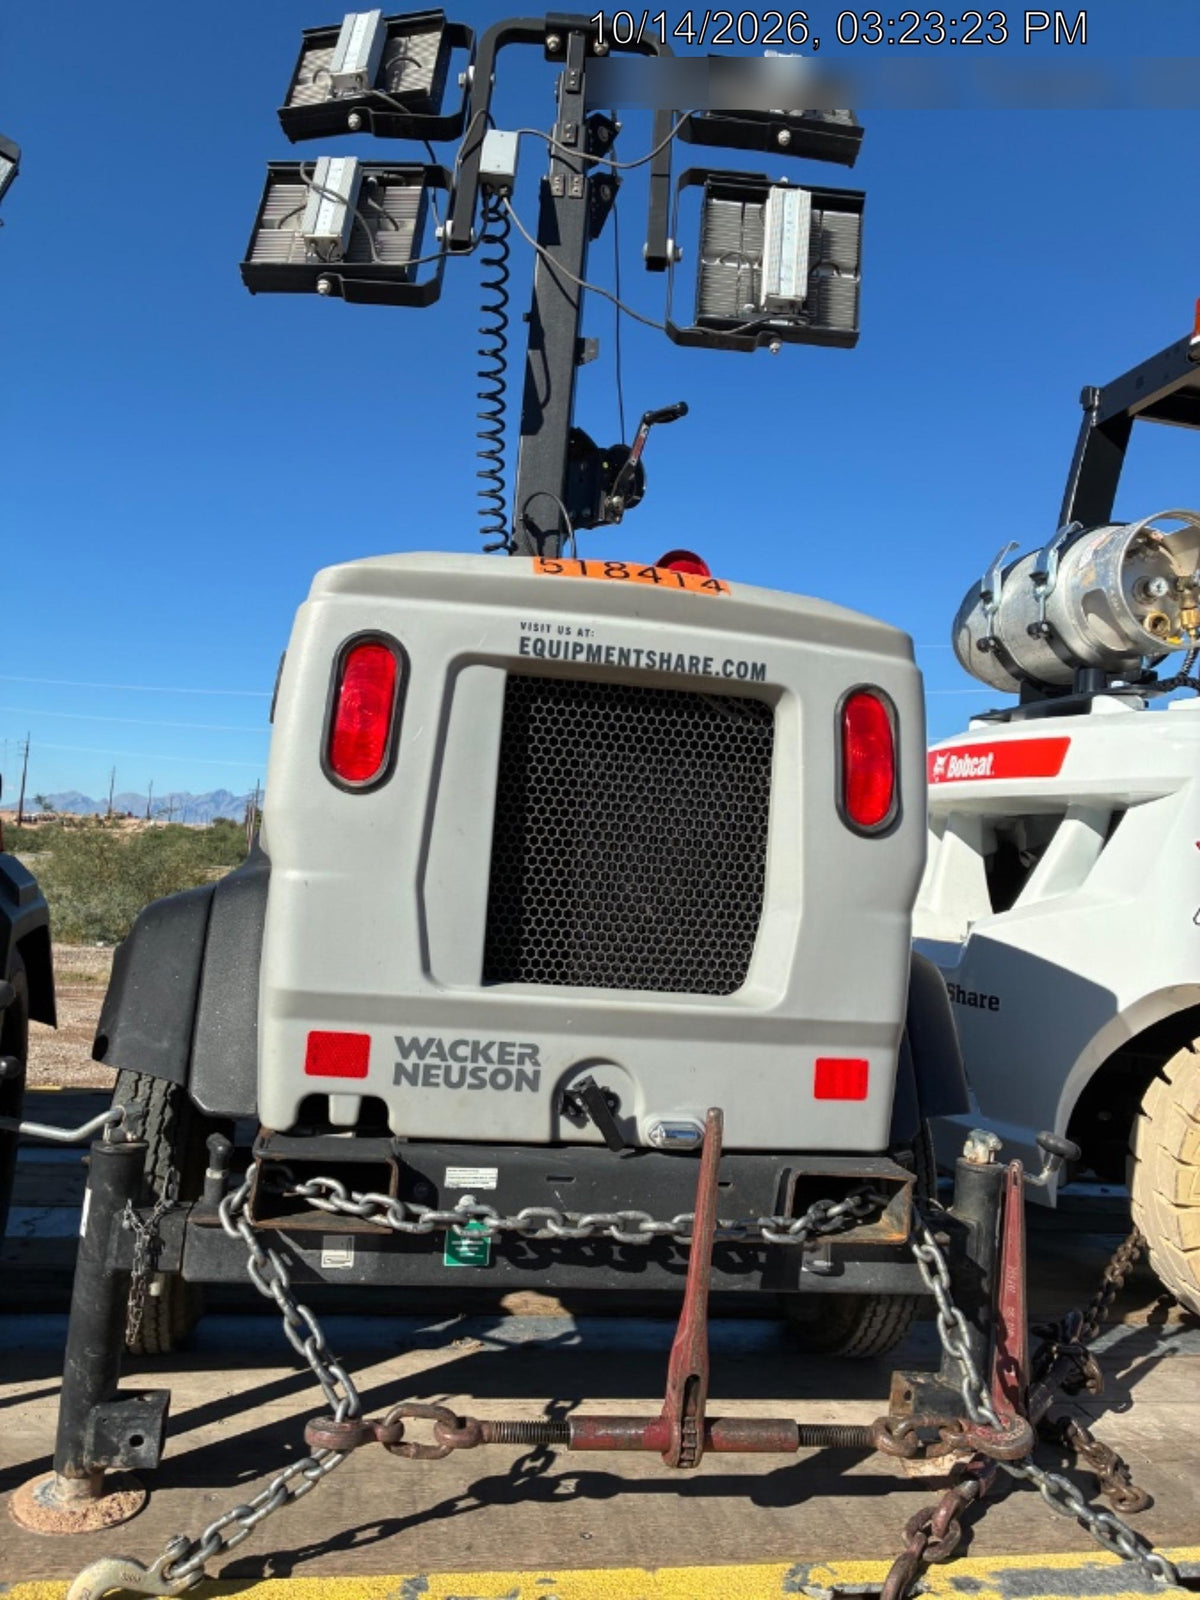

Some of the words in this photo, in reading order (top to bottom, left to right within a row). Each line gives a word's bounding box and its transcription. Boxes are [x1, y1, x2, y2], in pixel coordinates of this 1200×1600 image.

[539, 558, 725, 593] 518414
[520, 621, 551, 634] VISIT
[557, 625, 572, 636] US
[577, 628, 595, 638] AT:
[519, 636, 767, 681] EQUIPMENTSHARE.COM
[946, 751, 994, 778] Bobcat
[393, 1035, 541, 1067] WACKER
[392, 1062, 541, 1093] NEUSON
